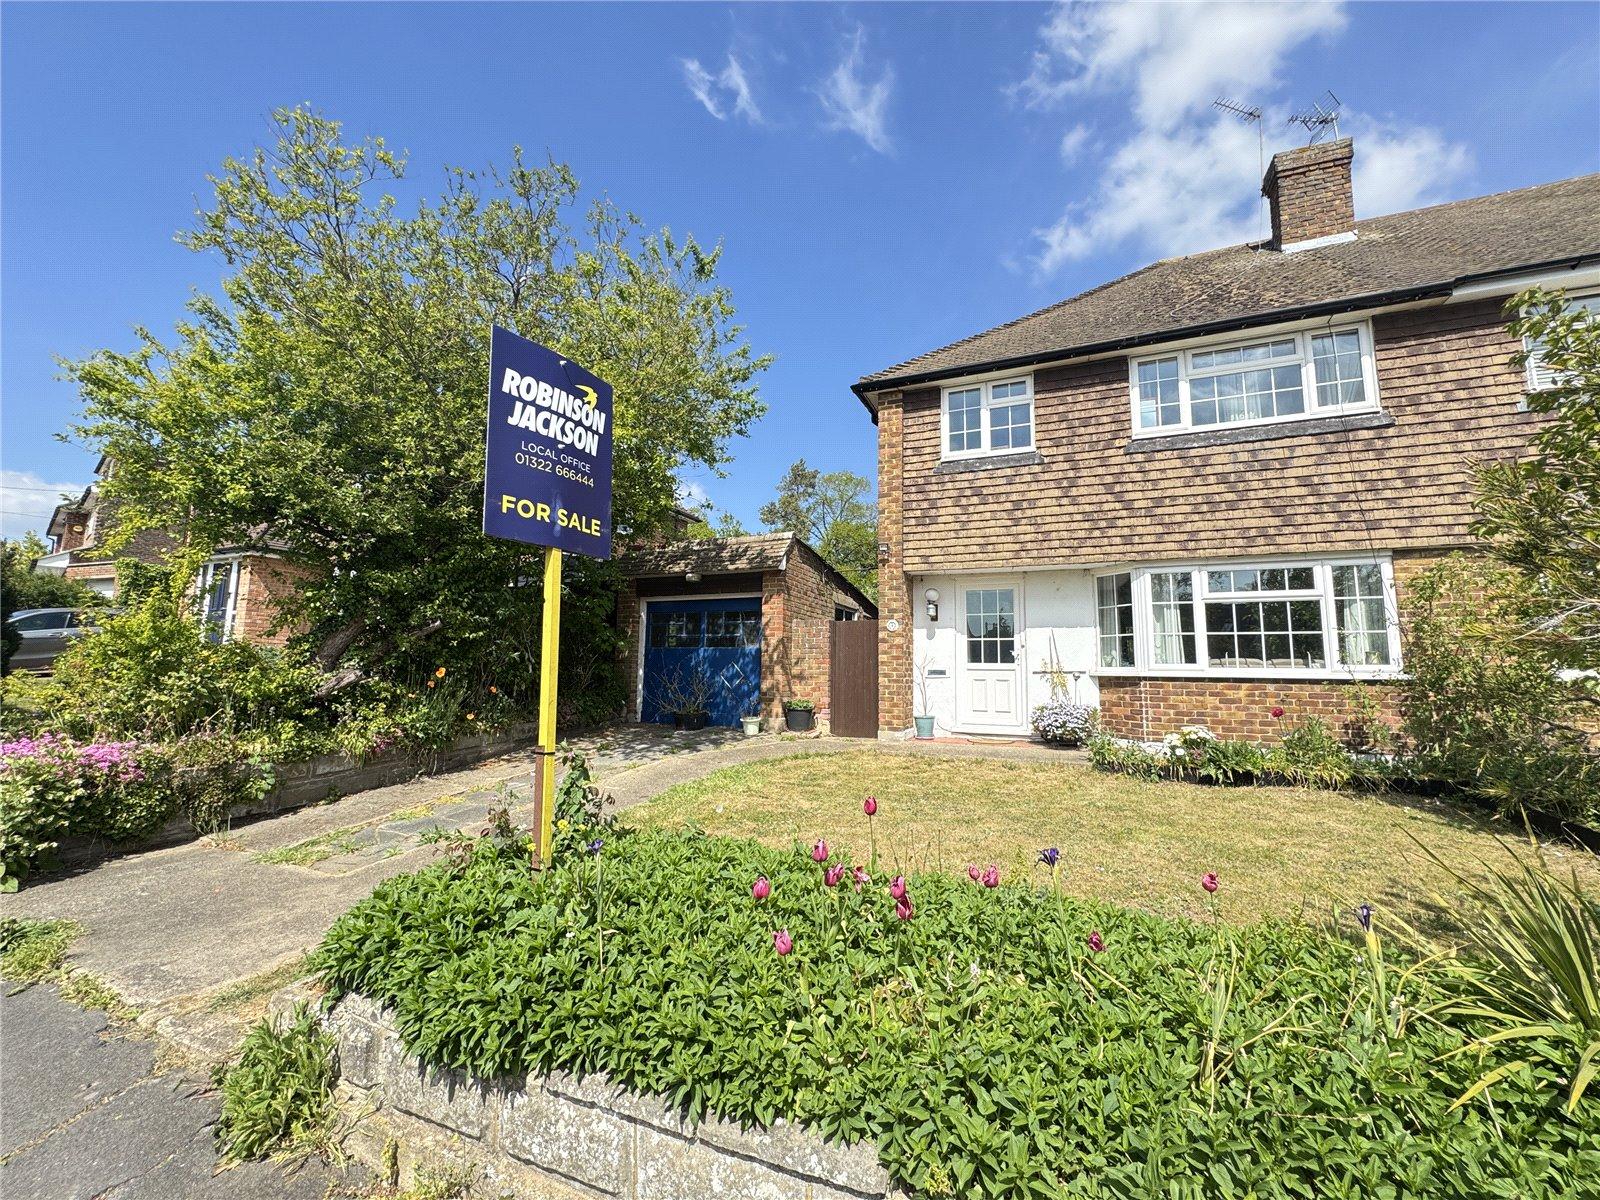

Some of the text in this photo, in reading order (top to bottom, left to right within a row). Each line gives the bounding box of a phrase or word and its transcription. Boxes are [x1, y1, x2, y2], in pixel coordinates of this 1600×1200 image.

[502, 367, 606, 435] ROBINSON
[507, 400, 600, 457] JACKSON
[515, 452, 594, 487] 01322 666444
[521, 440, 591, 473] LOCAL OFFICE
[501, 494, 601, 537] FOR SALE
